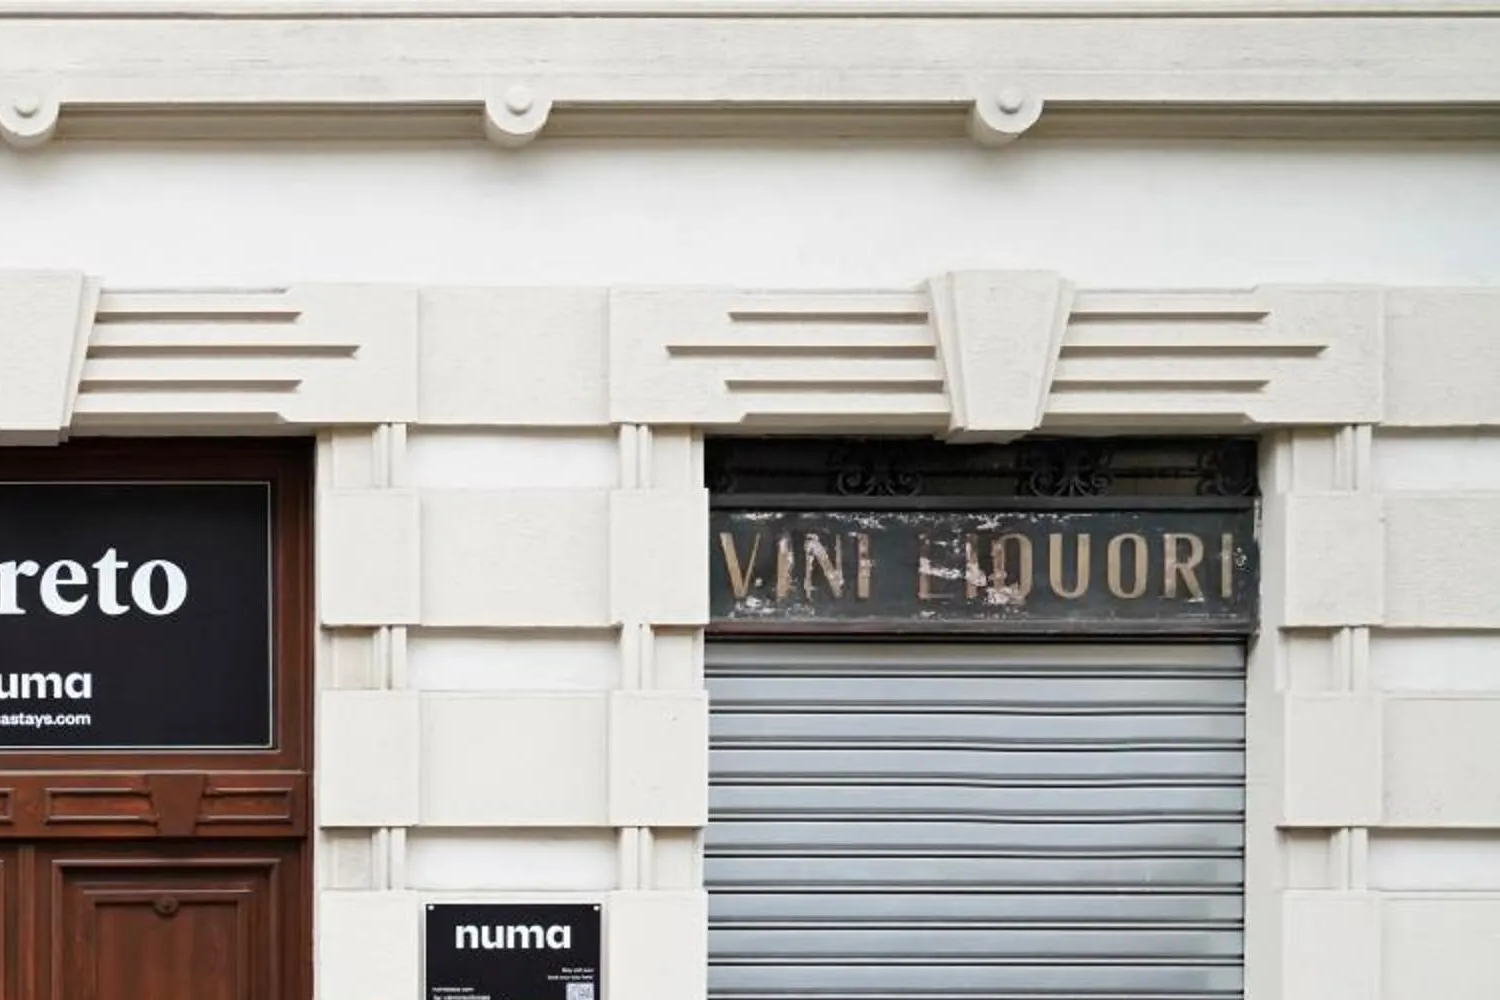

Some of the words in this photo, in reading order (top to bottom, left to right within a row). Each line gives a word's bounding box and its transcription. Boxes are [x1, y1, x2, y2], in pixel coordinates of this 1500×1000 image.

[719, 532, 872, 600] VINI
[917, 532, 1234, 603] LIQUORI
[455, 924, 572, 950] numa
